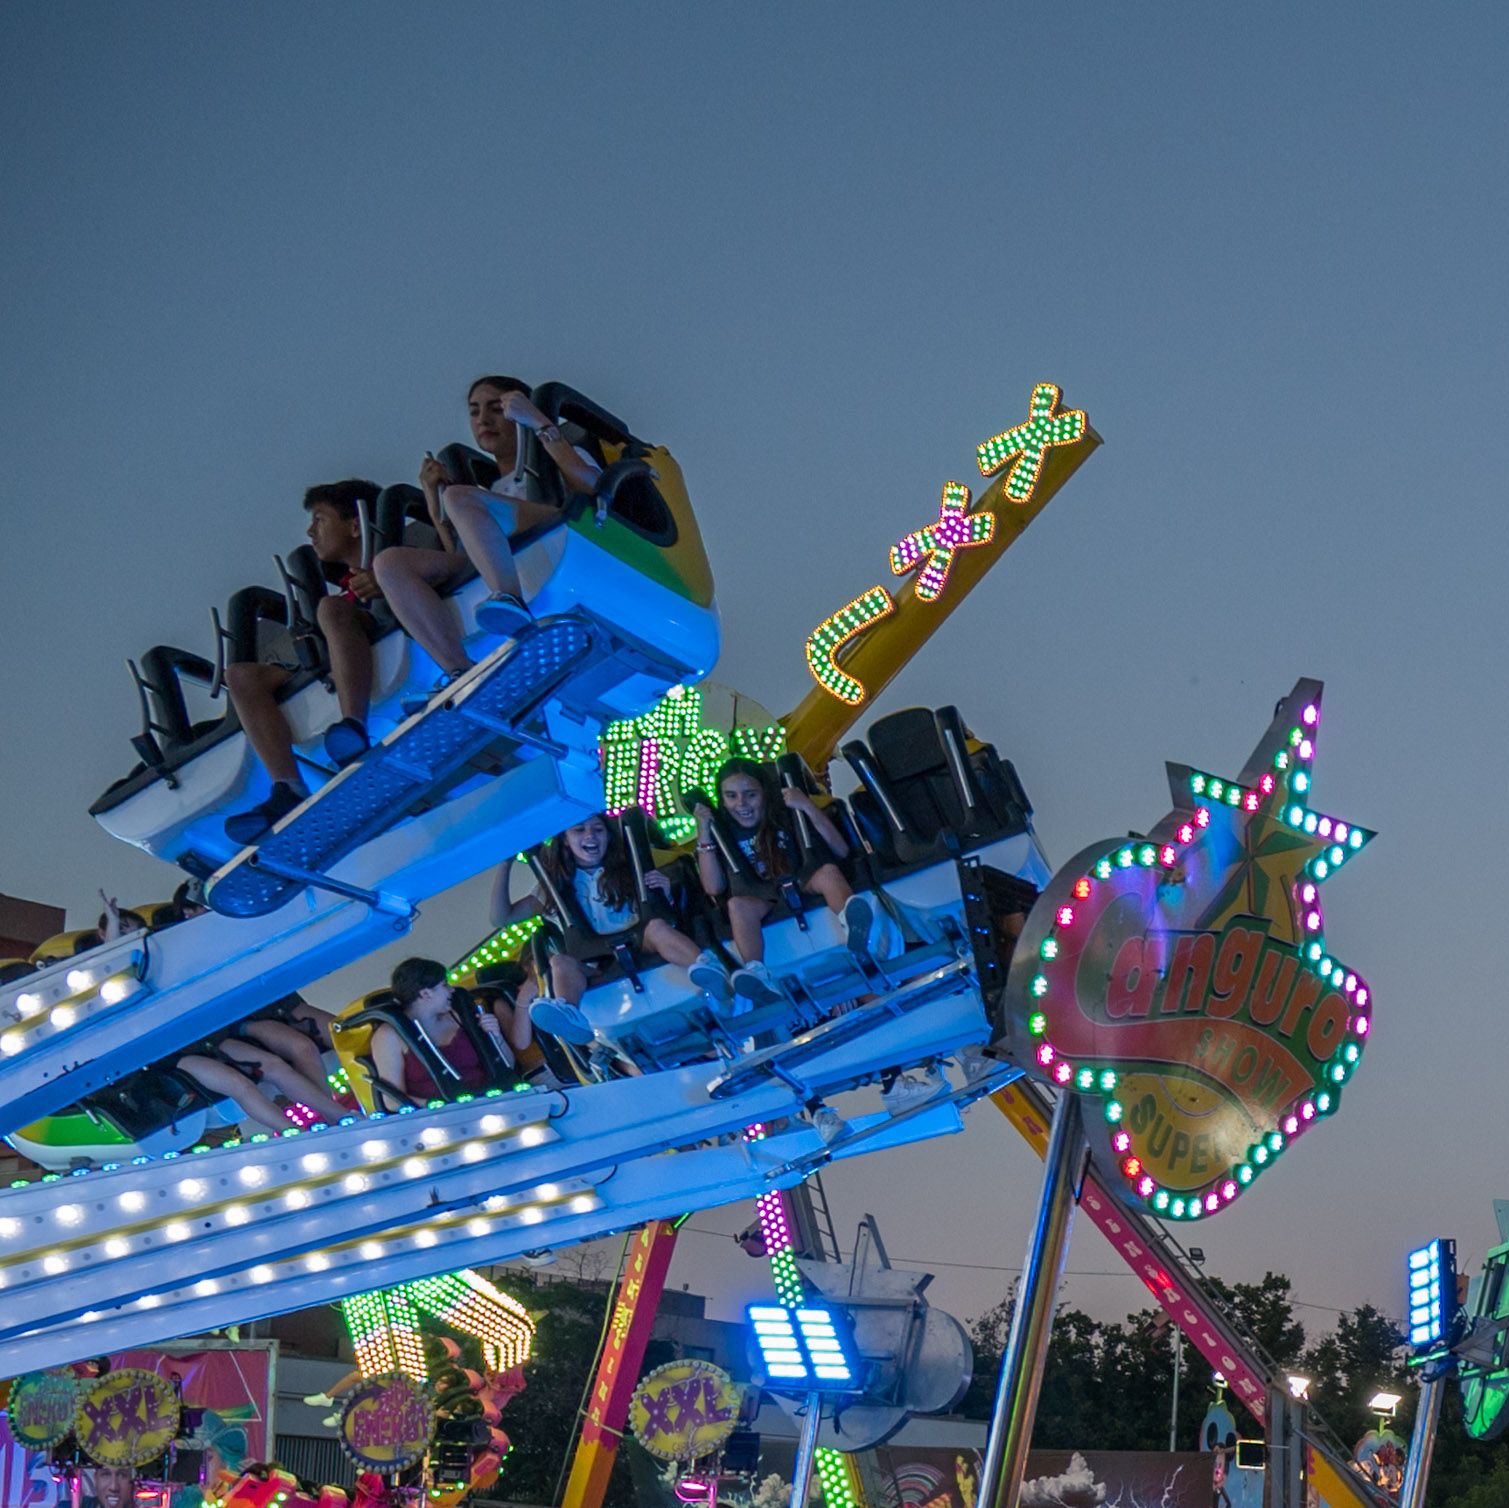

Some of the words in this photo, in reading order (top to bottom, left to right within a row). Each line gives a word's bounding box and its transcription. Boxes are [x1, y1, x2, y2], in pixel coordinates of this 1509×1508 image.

[1039, 868, 1352, 1093] Canguro
[1193, 1026, 1289, 1105] SHOW
[83, 1384, 175, 1449] XXL
[639, 1374, 734, 1440] XXL
